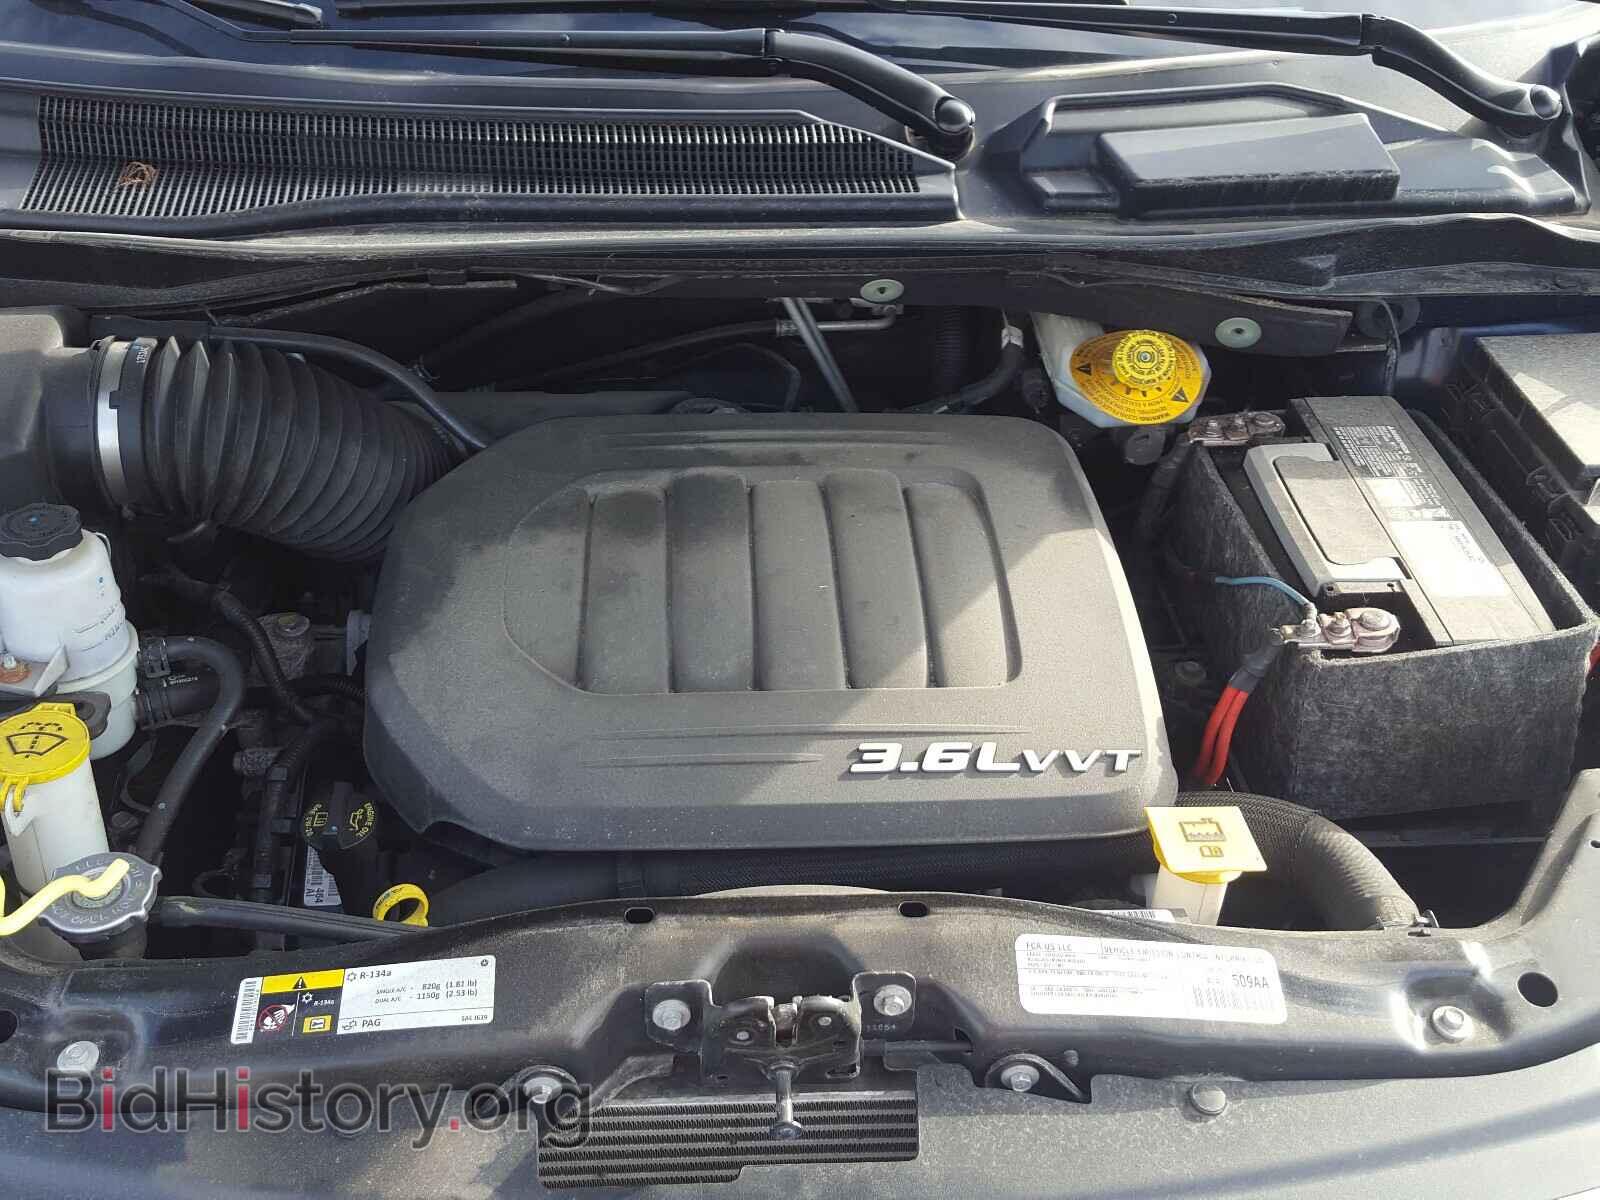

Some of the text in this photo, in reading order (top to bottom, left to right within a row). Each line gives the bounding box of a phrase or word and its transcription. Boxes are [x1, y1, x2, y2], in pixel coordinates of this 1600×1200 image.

[359, 969, 392, 980] R-134a
[422, 982, 441, 991] 820g
[374, 996, 389, 1004] DUAL
[416, 991, 441, 1000] 1150g
[361, 1018, 382, 1028] PAG
